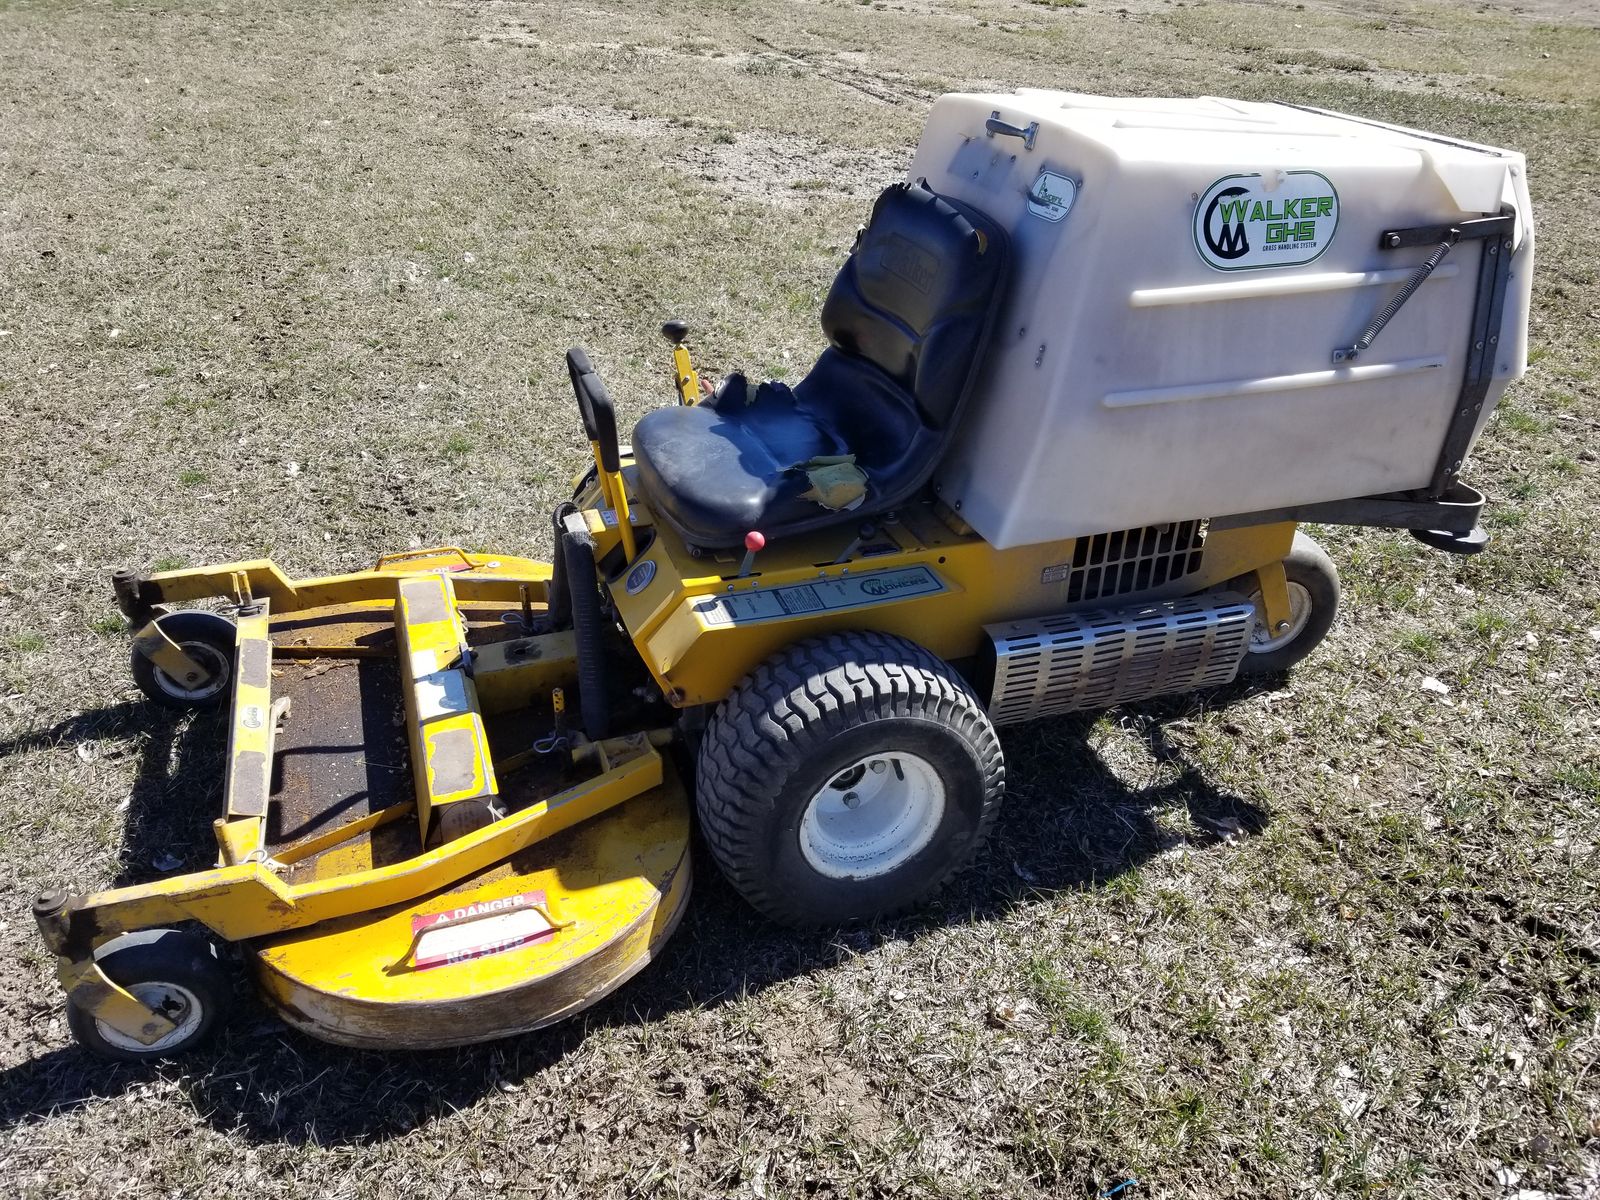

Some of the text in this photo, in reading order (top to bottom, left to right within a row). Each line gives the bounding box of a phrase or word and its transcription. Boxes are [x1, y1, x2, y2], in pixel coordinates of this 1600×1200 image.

[1219, 196, 1334, 223] WALKER
[1266, 221, 1315, 243] GHS
[1278, 243, 1299, 251] HANDLING
[1300, 241, 1317, 249] SYSTEM
[454, 895, 524, 919] DANGER
[446, 937, 525, 964] NO STEP
